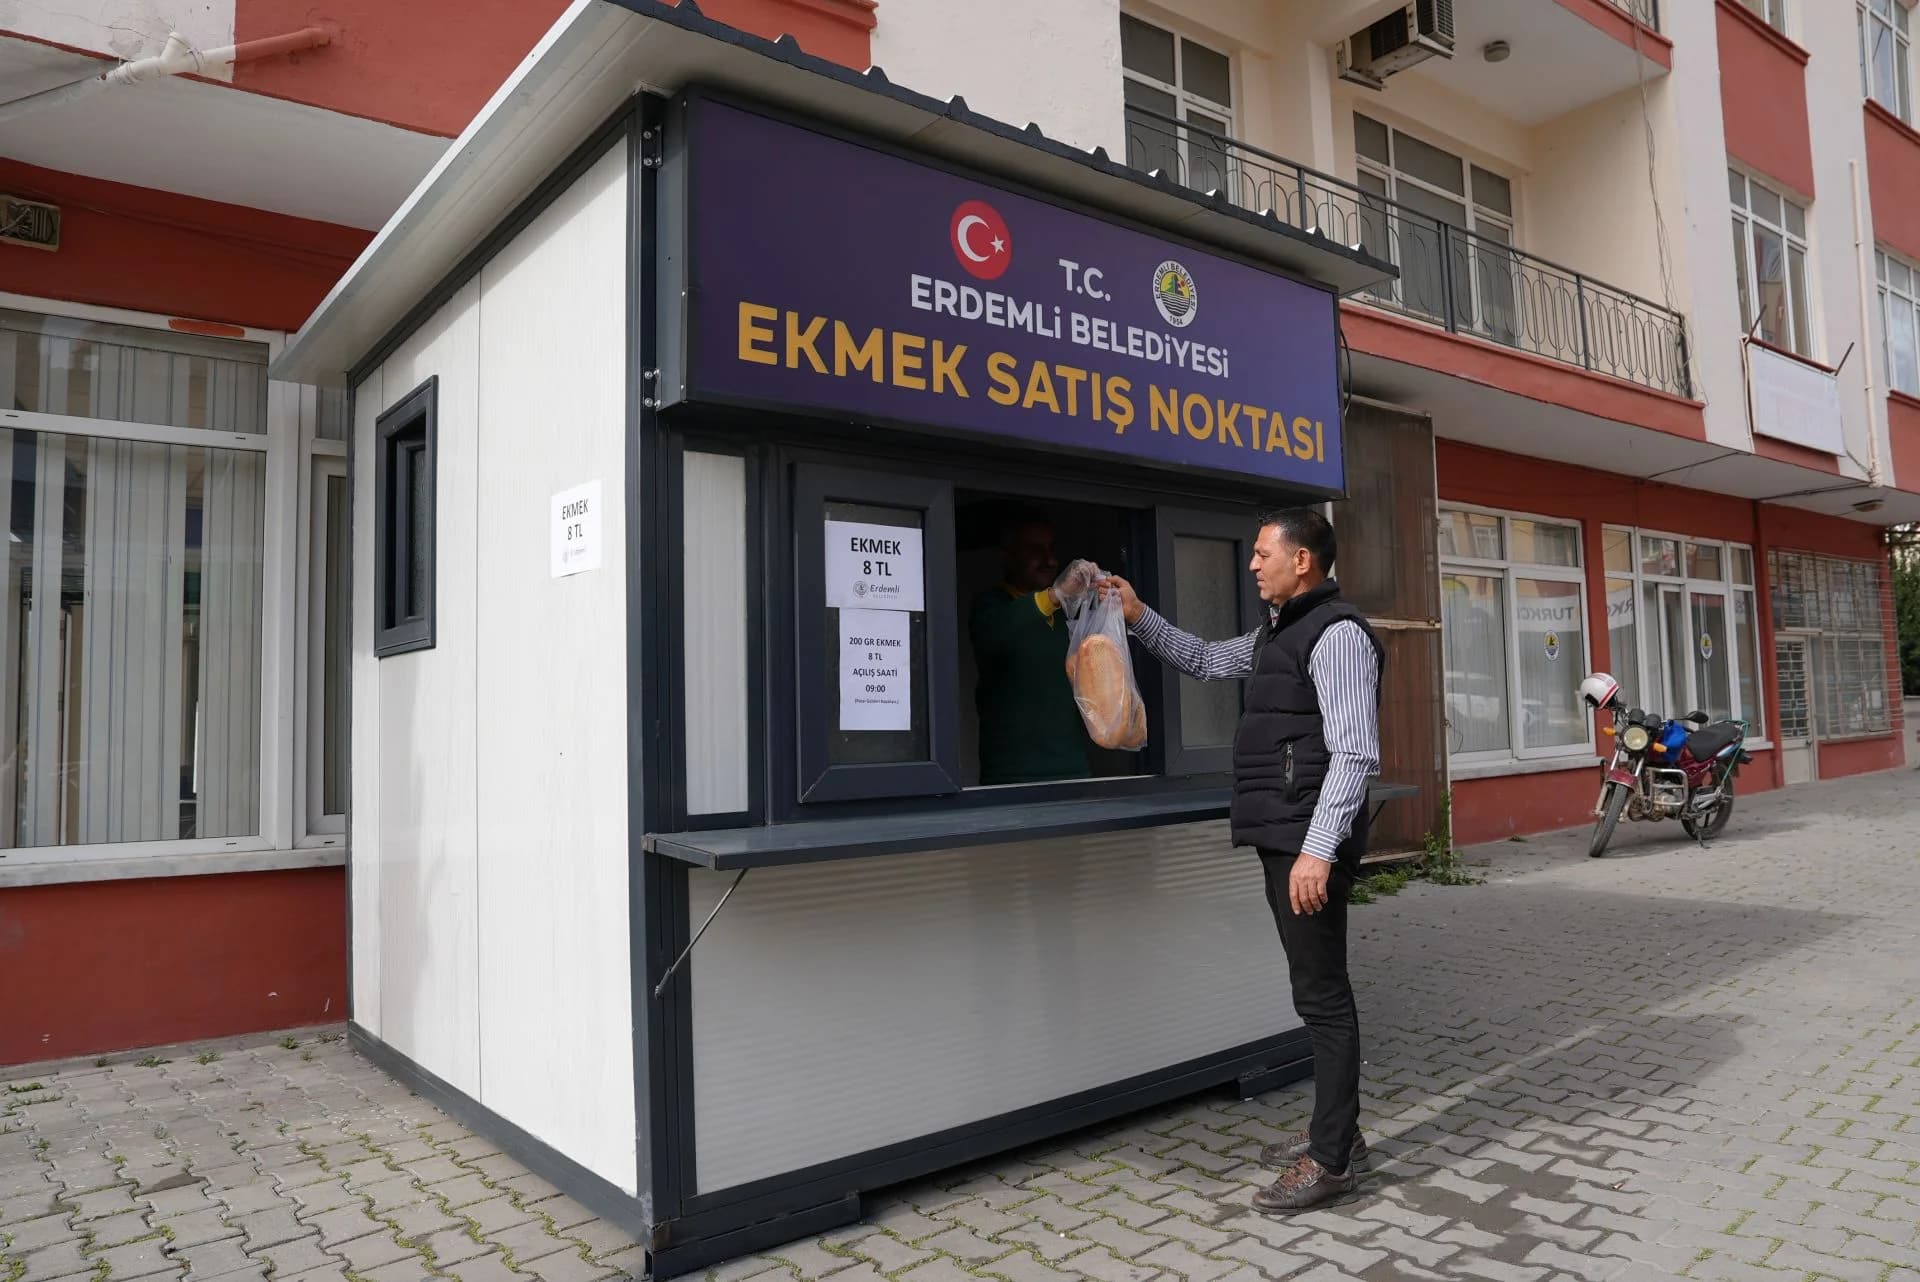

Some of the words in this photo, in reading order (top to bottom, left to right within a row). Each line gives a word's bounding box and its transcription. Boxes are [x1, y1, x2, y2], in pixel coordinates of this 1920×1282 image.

[1059, 259, 1111, 301] T.C.
[738, 301, 970, 399] EKMEK
[986, 351, 1135, 434] SATIŞ
[1149, 383, 1324, 463] NOKTASI
[562, 498, 588, 520] EKMEK
[567, 525, 573, 541] 8
[574, 523, 583, 538] TL
[850, 537, 901, 556] EKMEK
[863, 560, 872, 575] 8
[875, 561, 892, 576] TL
[870, 584, 900, 593] Erdemli
[849, 637, 863, 646] 200
[864, 637, 875, 646] GR
[876, 638, 901, 648] EKMEK
[868, 652, 873, 661] 8
[875, 652, 884, 661] TL
[852, 667, 875, 678] AÇILIŞ
[865, 684, 886, 693] 09:00
